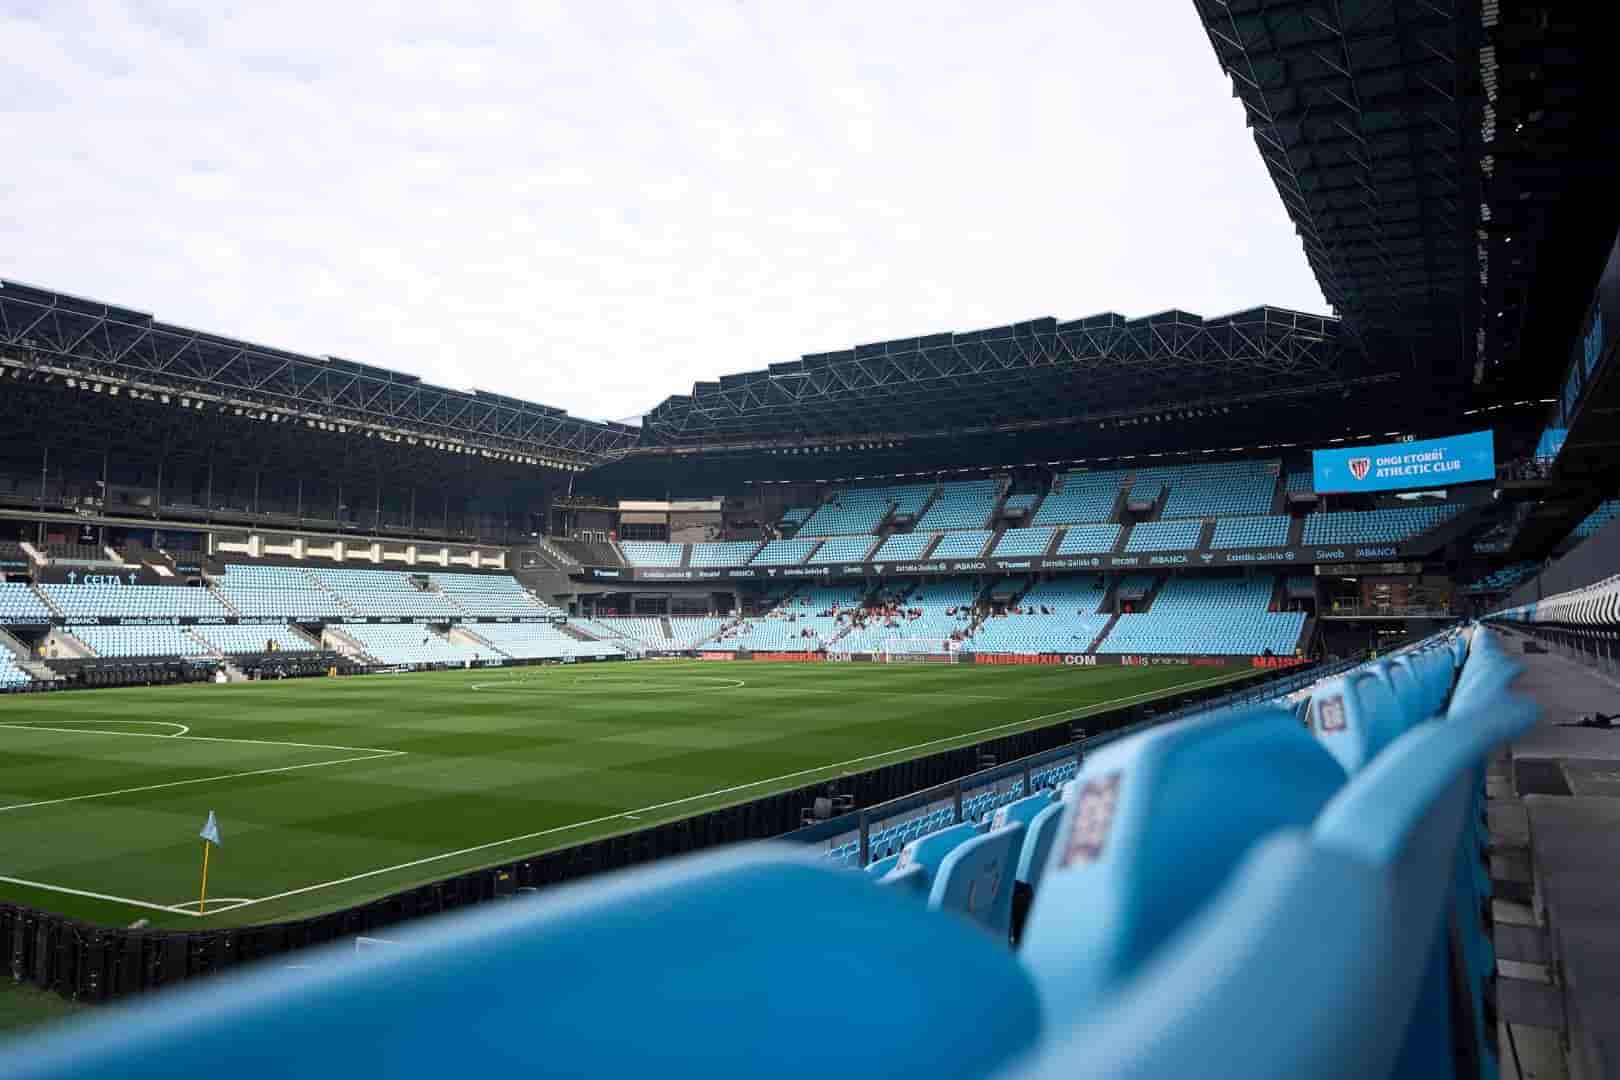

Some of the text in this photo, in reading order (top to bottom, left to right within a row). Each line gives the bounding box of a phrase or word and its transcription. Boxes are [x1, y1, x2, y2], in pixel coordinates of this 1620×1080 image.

[1376, 455, 1402, 466] ONGI
[1376, 460, 1462, 478] ATHLETIC CLUB
[83, 574, 121, 586] CELTA
